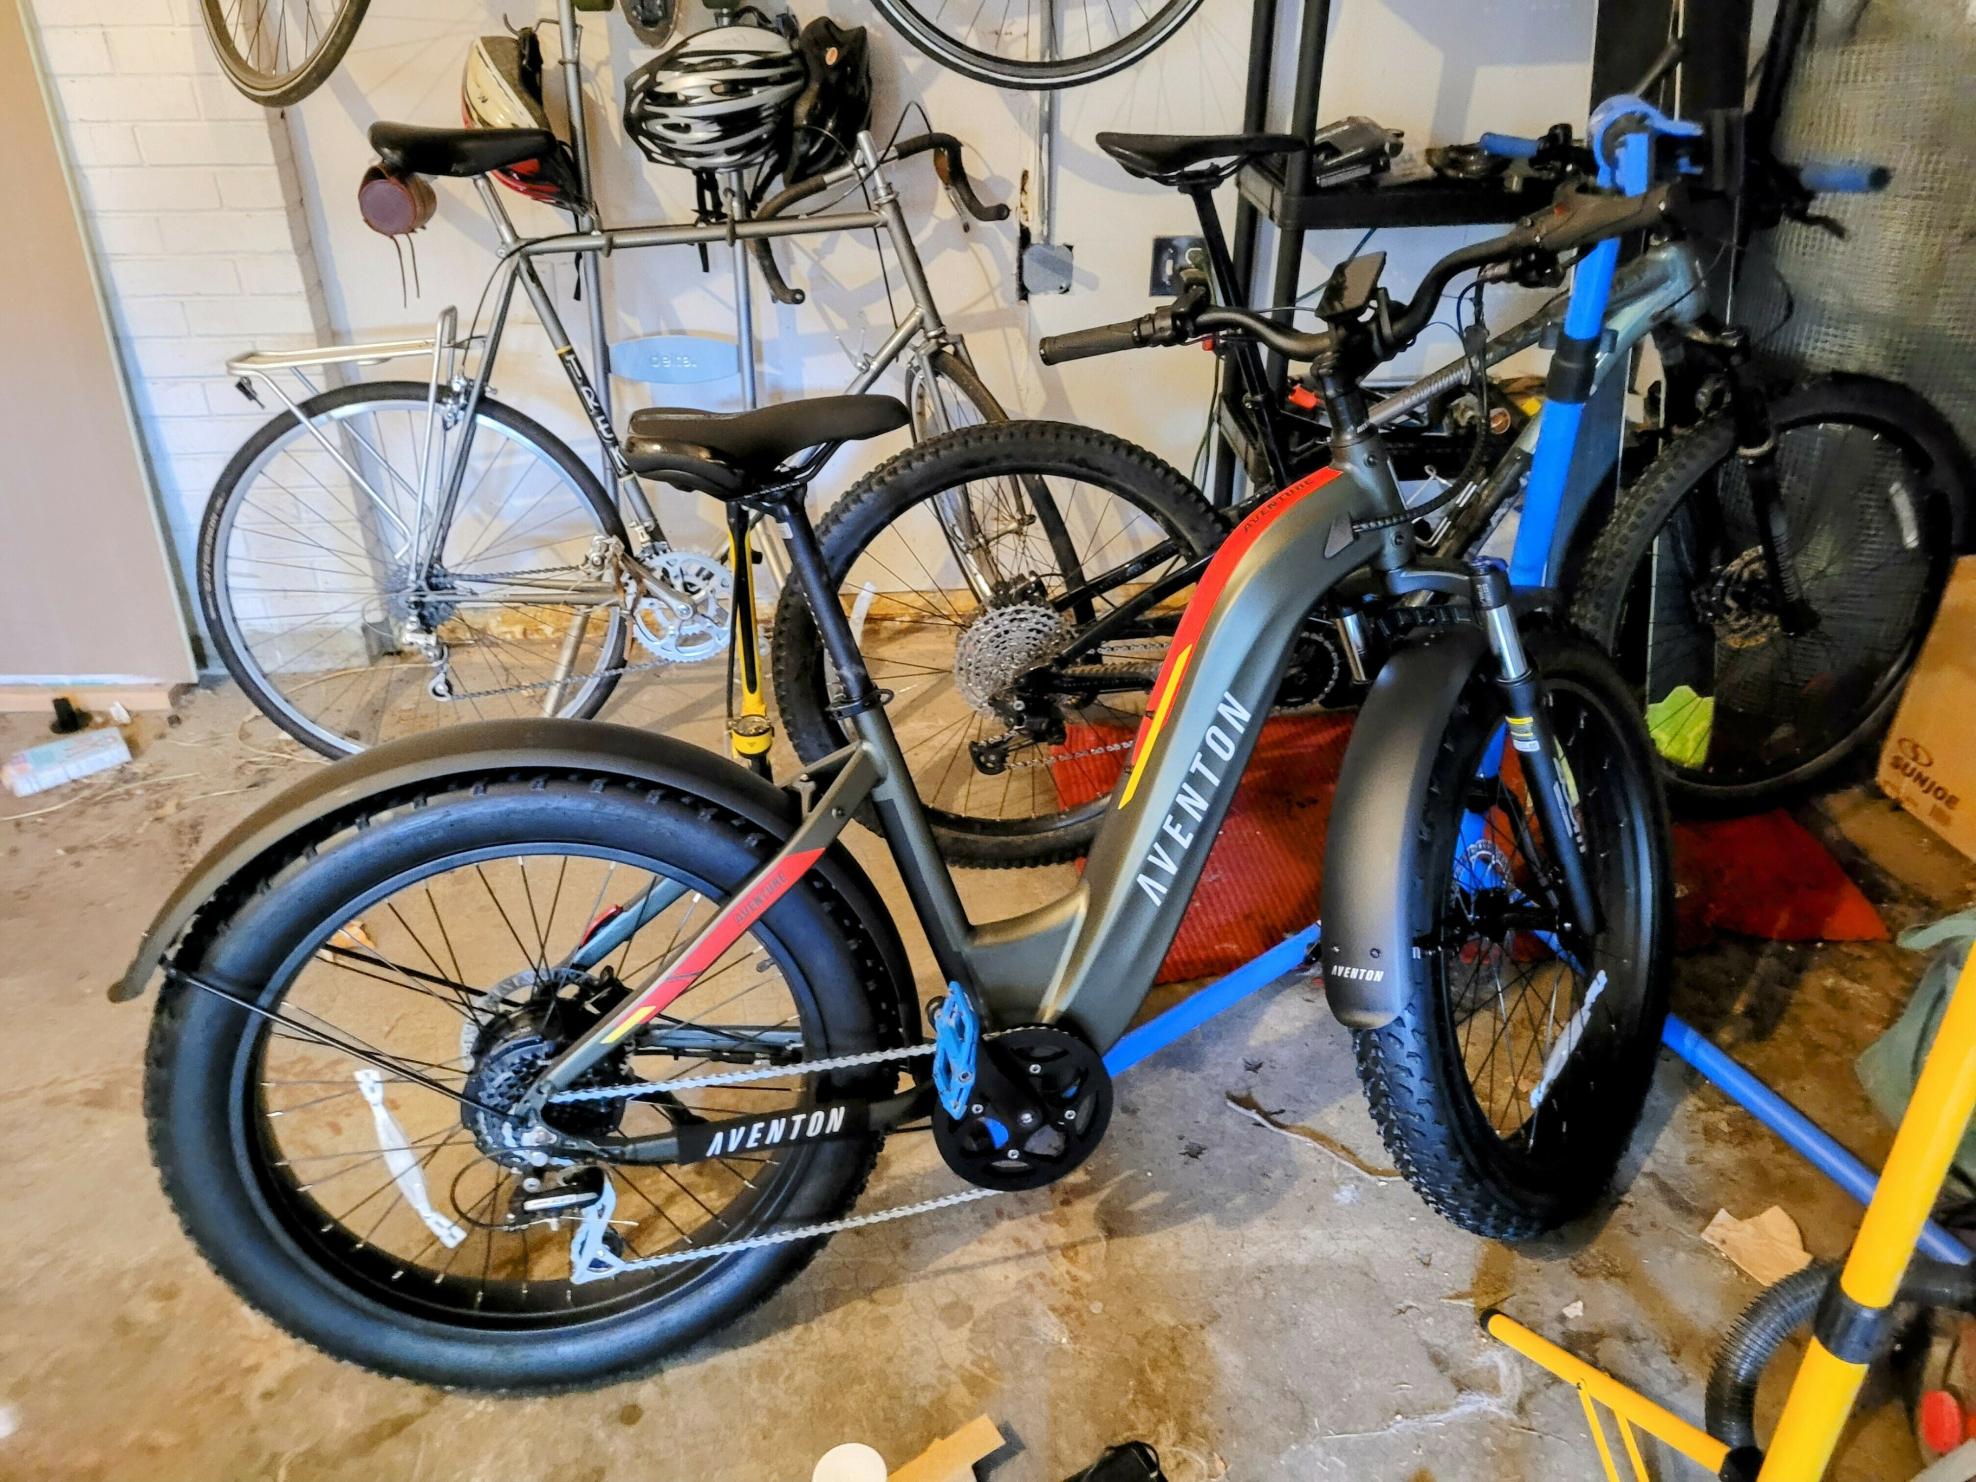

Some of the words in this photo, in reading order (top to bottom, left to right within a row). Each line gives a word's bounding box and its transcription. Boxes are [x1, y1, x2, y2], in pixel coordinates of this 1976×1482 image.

[564, 353, 630, 477] TREK
[1244, 480, 1314, 532] AVENTURE
[1136, 691, 1252, 907] AVENTON
[1331, 965, 1384, 982] AVENTON
[706, 1106, 845, 1157] AVENTON
